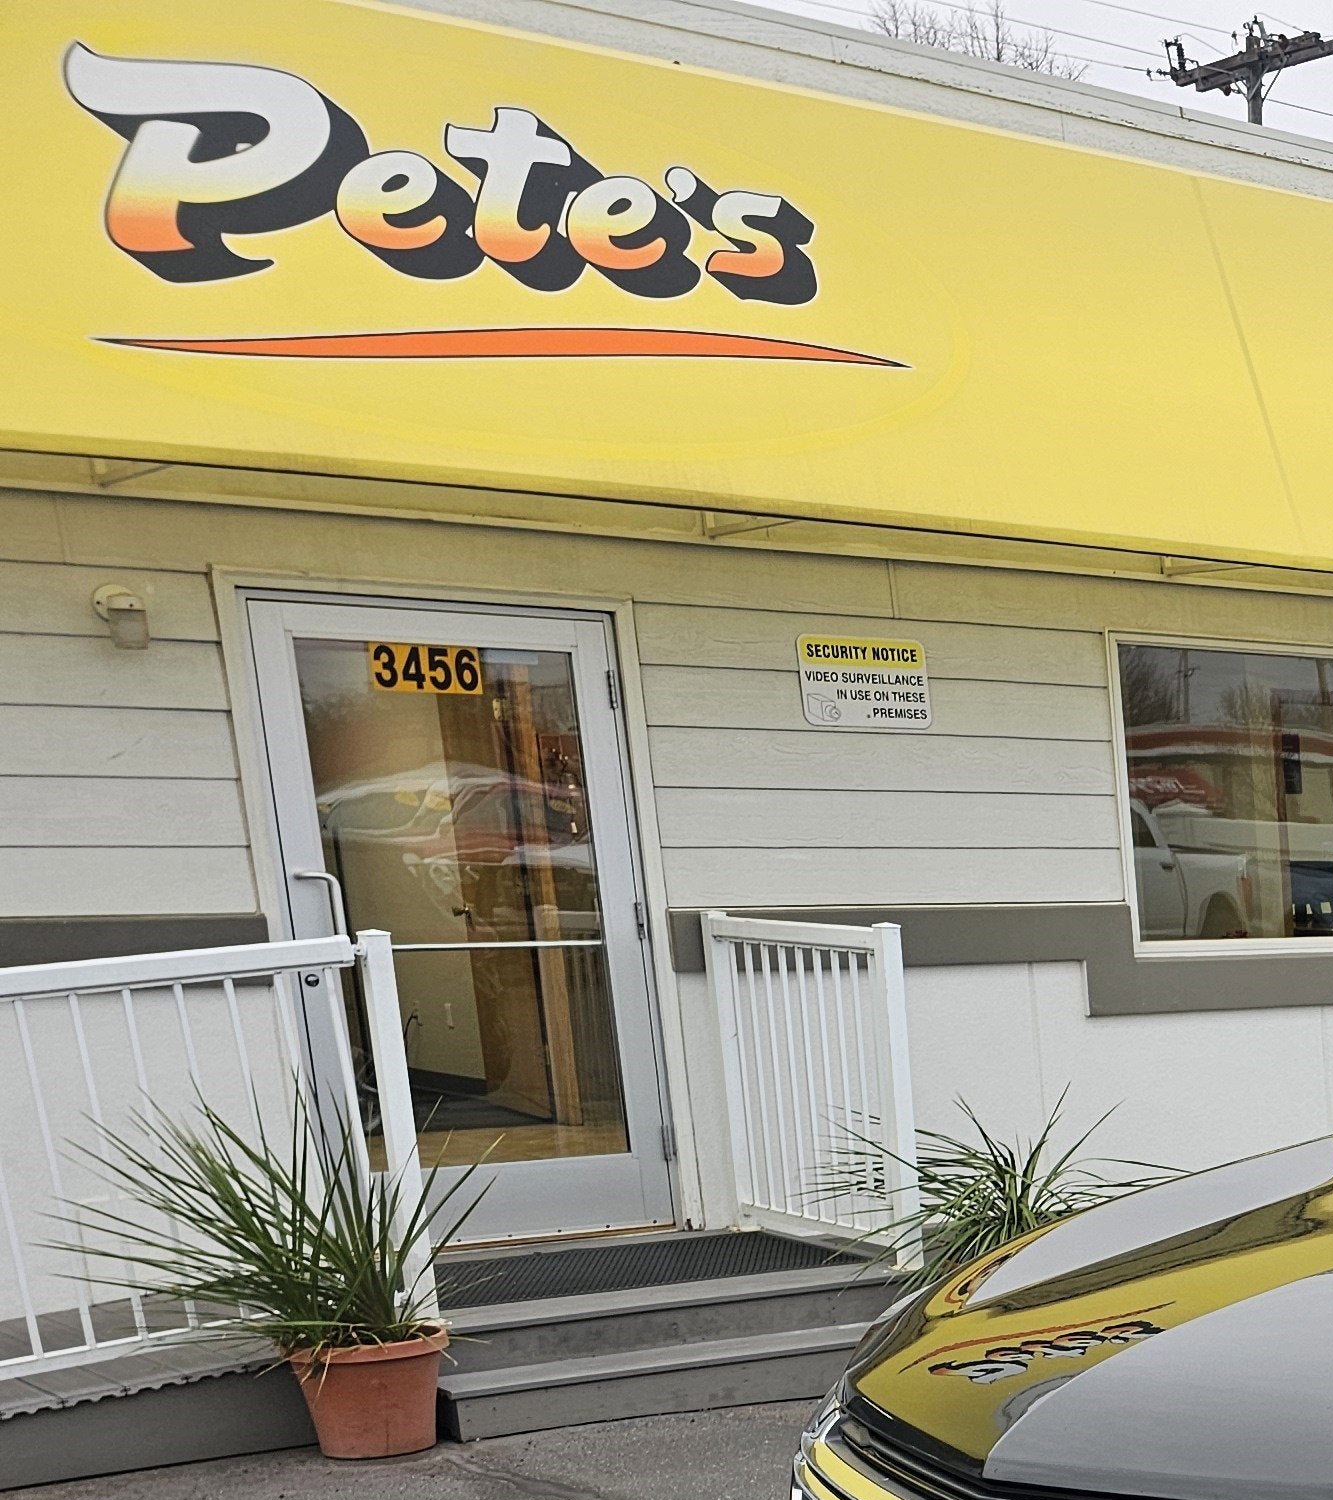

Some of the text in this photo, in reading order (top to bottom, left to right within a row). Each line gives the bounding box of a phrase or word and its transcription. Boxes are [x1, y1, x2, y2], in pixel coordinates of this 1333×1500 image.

[63, 40, 818, 305] Pete's
[806, 643, 918, 663] SECURITY NOTICE
[371, 643, 480, 692] 3456
[804, 670, 924, 687] VIDEO SURVEILLANCE
[836, 689, 926, 703] IN USE ON THESE
[872, 707, 928, 720] PREMISES
